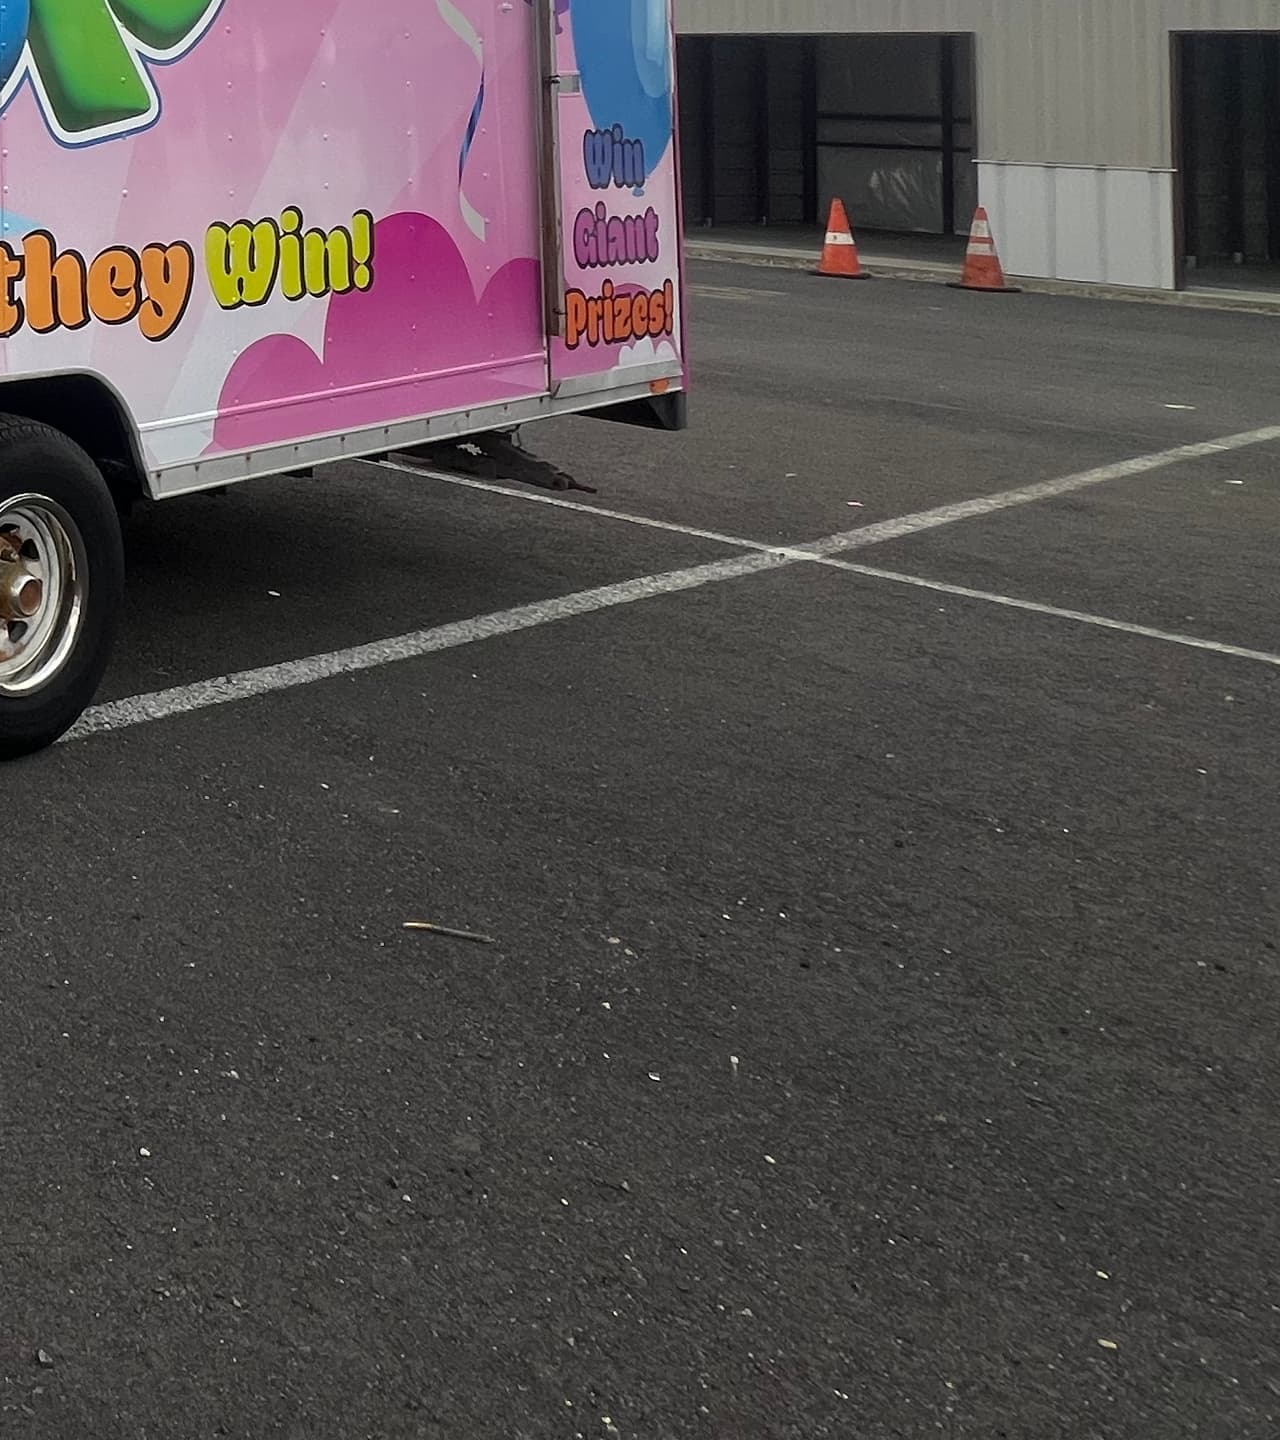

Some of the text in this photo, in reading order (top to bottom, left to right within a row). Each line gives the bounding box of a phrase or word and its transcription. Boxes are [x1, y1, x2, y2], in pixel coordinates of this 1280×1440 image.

[583, 124, 645, 189] Win
[204, 206, 375, 310] Win!
[573, 202, 659, 269] Giant
[565, 279, 673, 349] Prizes!
